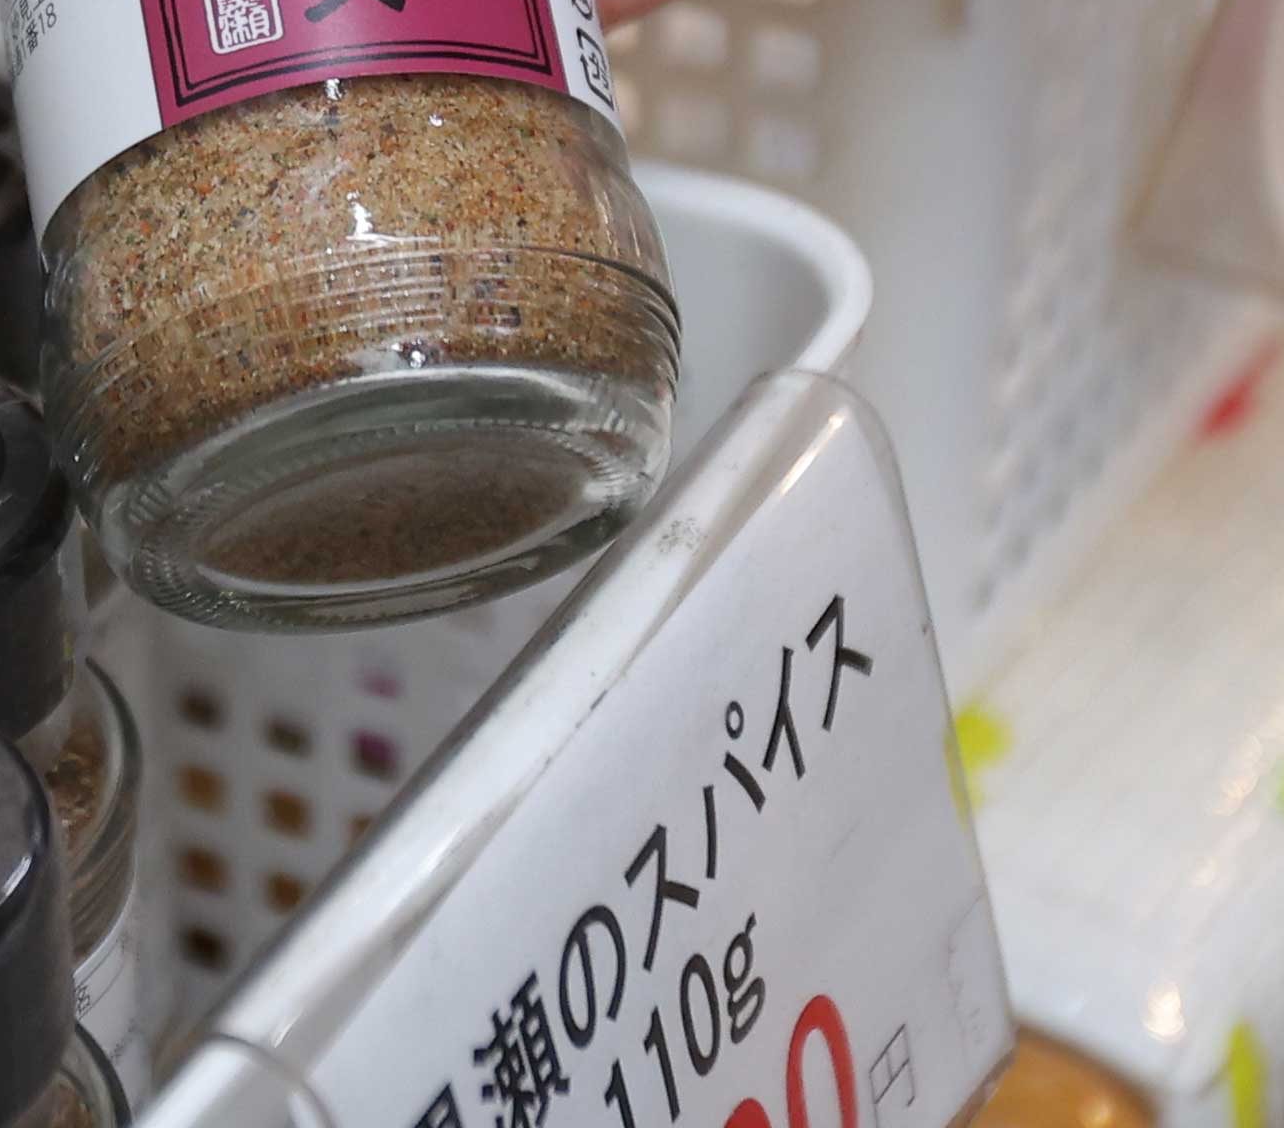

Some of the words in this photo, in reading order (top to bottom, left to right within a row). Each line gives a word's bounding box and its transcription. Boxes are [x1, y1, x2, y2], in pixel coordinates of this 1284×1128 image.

[411, 594, 873, 1128] 瀬のスパイス
[604, 913, 766, 1128] 110g
